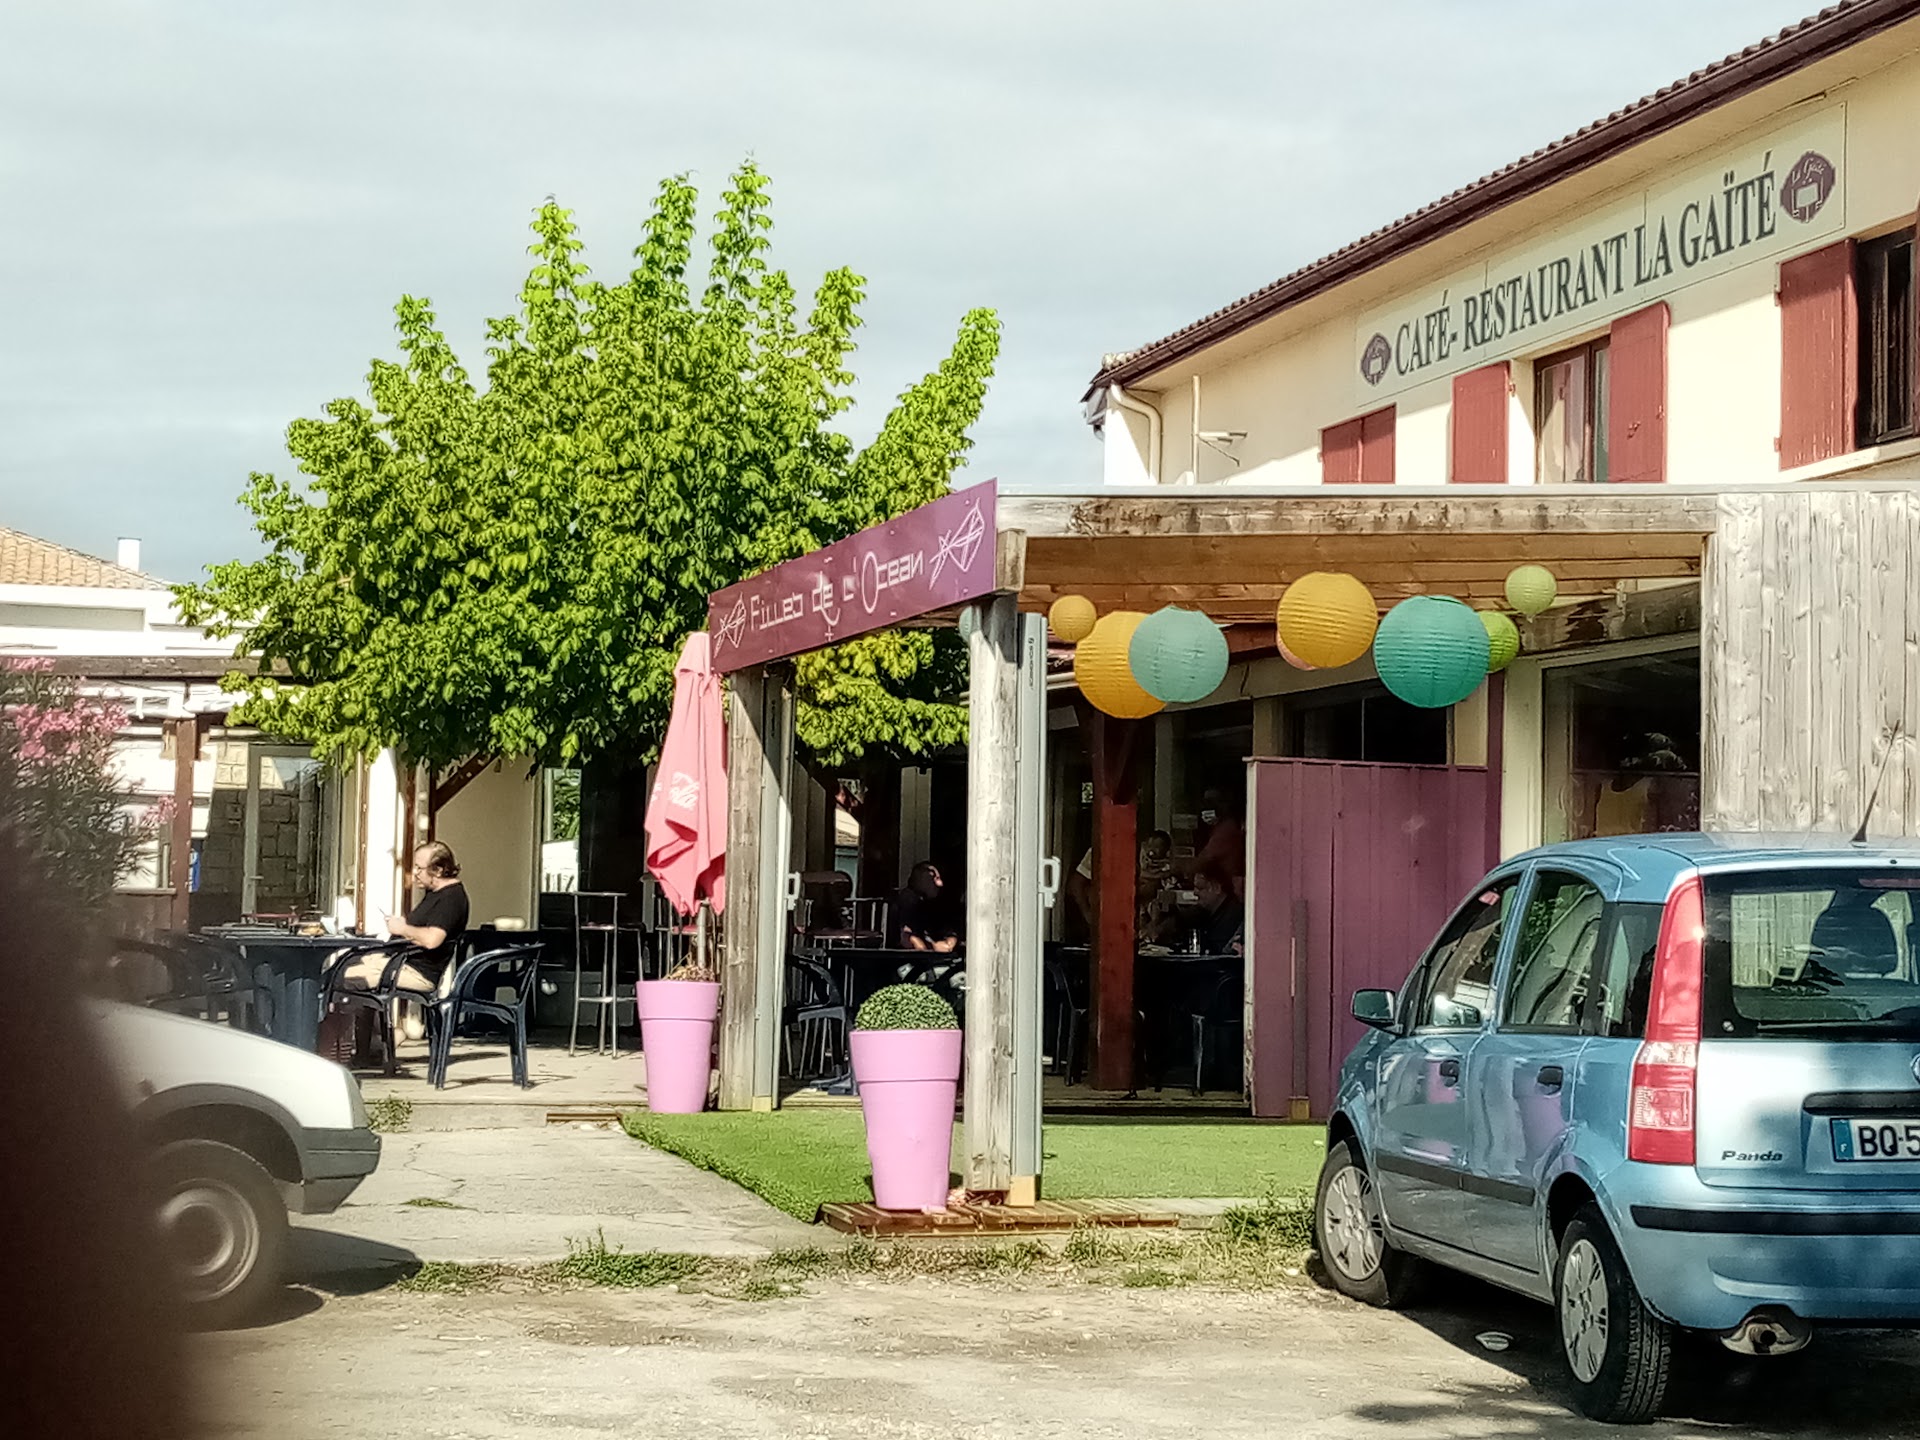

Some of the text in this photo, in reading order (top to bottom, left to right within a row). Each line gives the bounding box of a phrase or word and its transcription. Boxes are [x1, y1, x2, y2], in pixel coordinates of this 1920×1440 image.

[1463, 232, 1628, 353] RESTAURANT
[1634, 216, 1673, 287] LA
[1679, 149, 1777, 268] GAÏTÉ
[812, 571, 837, 620] de
[1721, 1150, 1783, 1162] Panda
